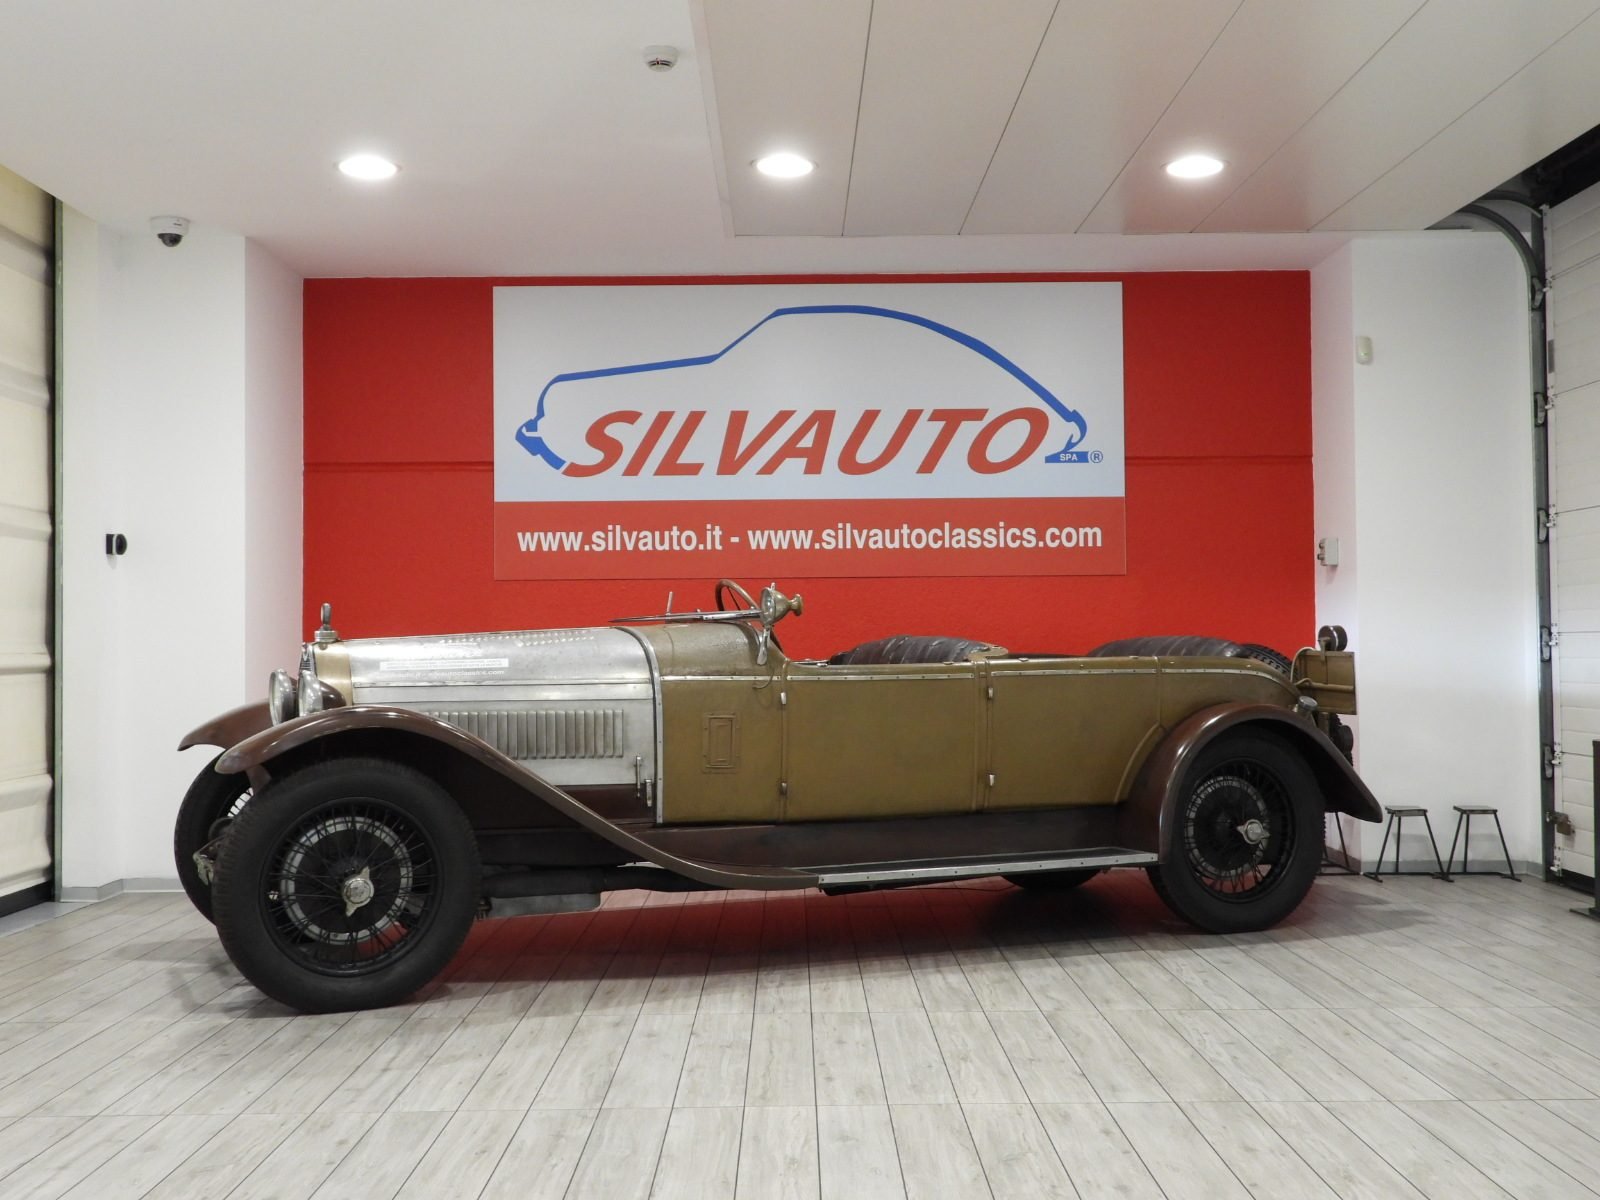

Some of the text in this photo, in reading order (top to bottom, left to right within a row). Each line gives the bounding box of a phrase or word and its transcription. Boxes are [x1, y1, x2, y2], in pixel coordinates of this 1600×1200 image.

[563, 407, 1050, 478] SILVAUTO
[1060, 453, 1078, 462] SPA
[516, 523, 723, 552] www.silvauto.it
[746, 521, 1103, 550] www.silvautoclassics.com
